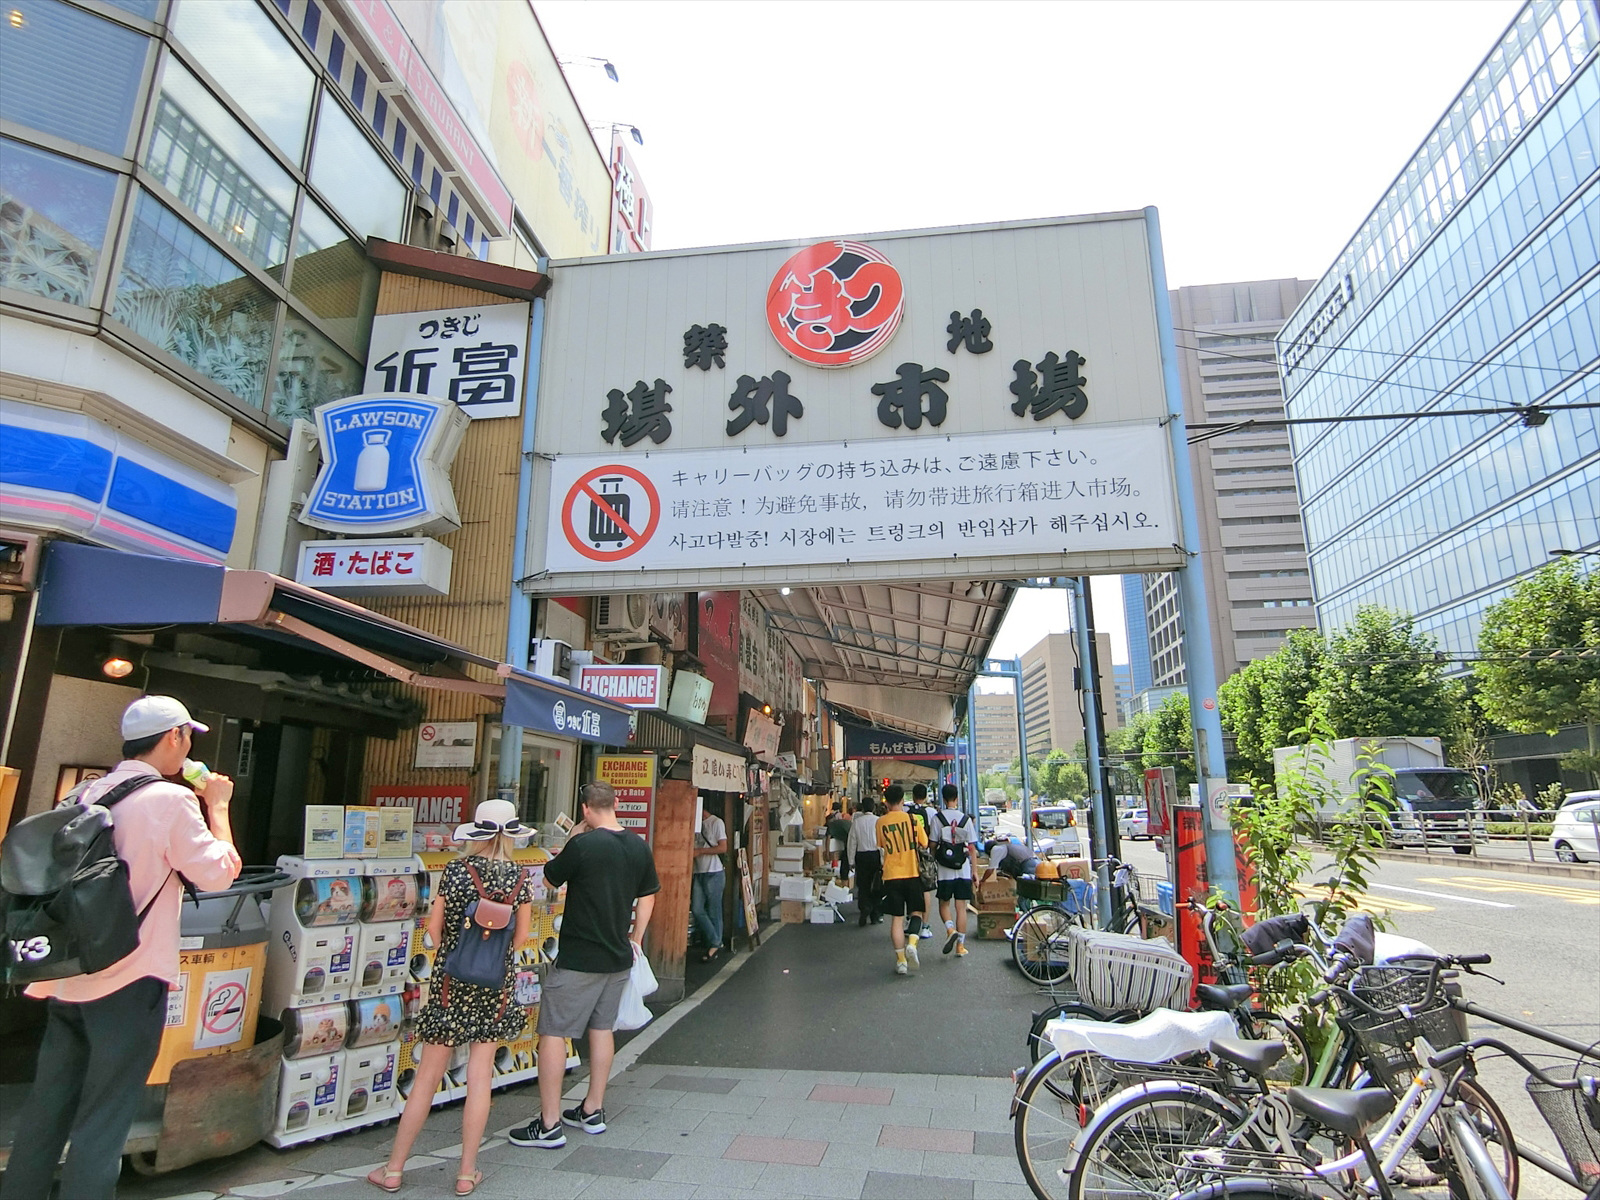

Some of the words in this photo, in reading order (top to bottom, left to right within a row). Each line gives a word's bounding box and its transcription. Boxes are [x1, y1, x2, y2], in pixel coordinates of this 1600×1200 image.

[399, 44, 475, 167] RESTAURANT
[418, 313, 482, 340] つきじ
[333, 411, 425, 434] LAWSON
[322, 487, 416, 511] STATION
[668, 530, 769, 552] 사고다발중!
[779, 526, 856, 548] 시장에는
[867, 520, 945, 542] 트렁크의
[957, 515, 1039, 538] 반입삼가
[1049, 511, 1159, 534] 해주십시오.
[583, 674, 655, 698] EXCHANGE
[869, 742, 937, 754] もんぜき通り
[602, 760, 648, 772] EXCHANGE
[628, 788, 646, 797] Rate
